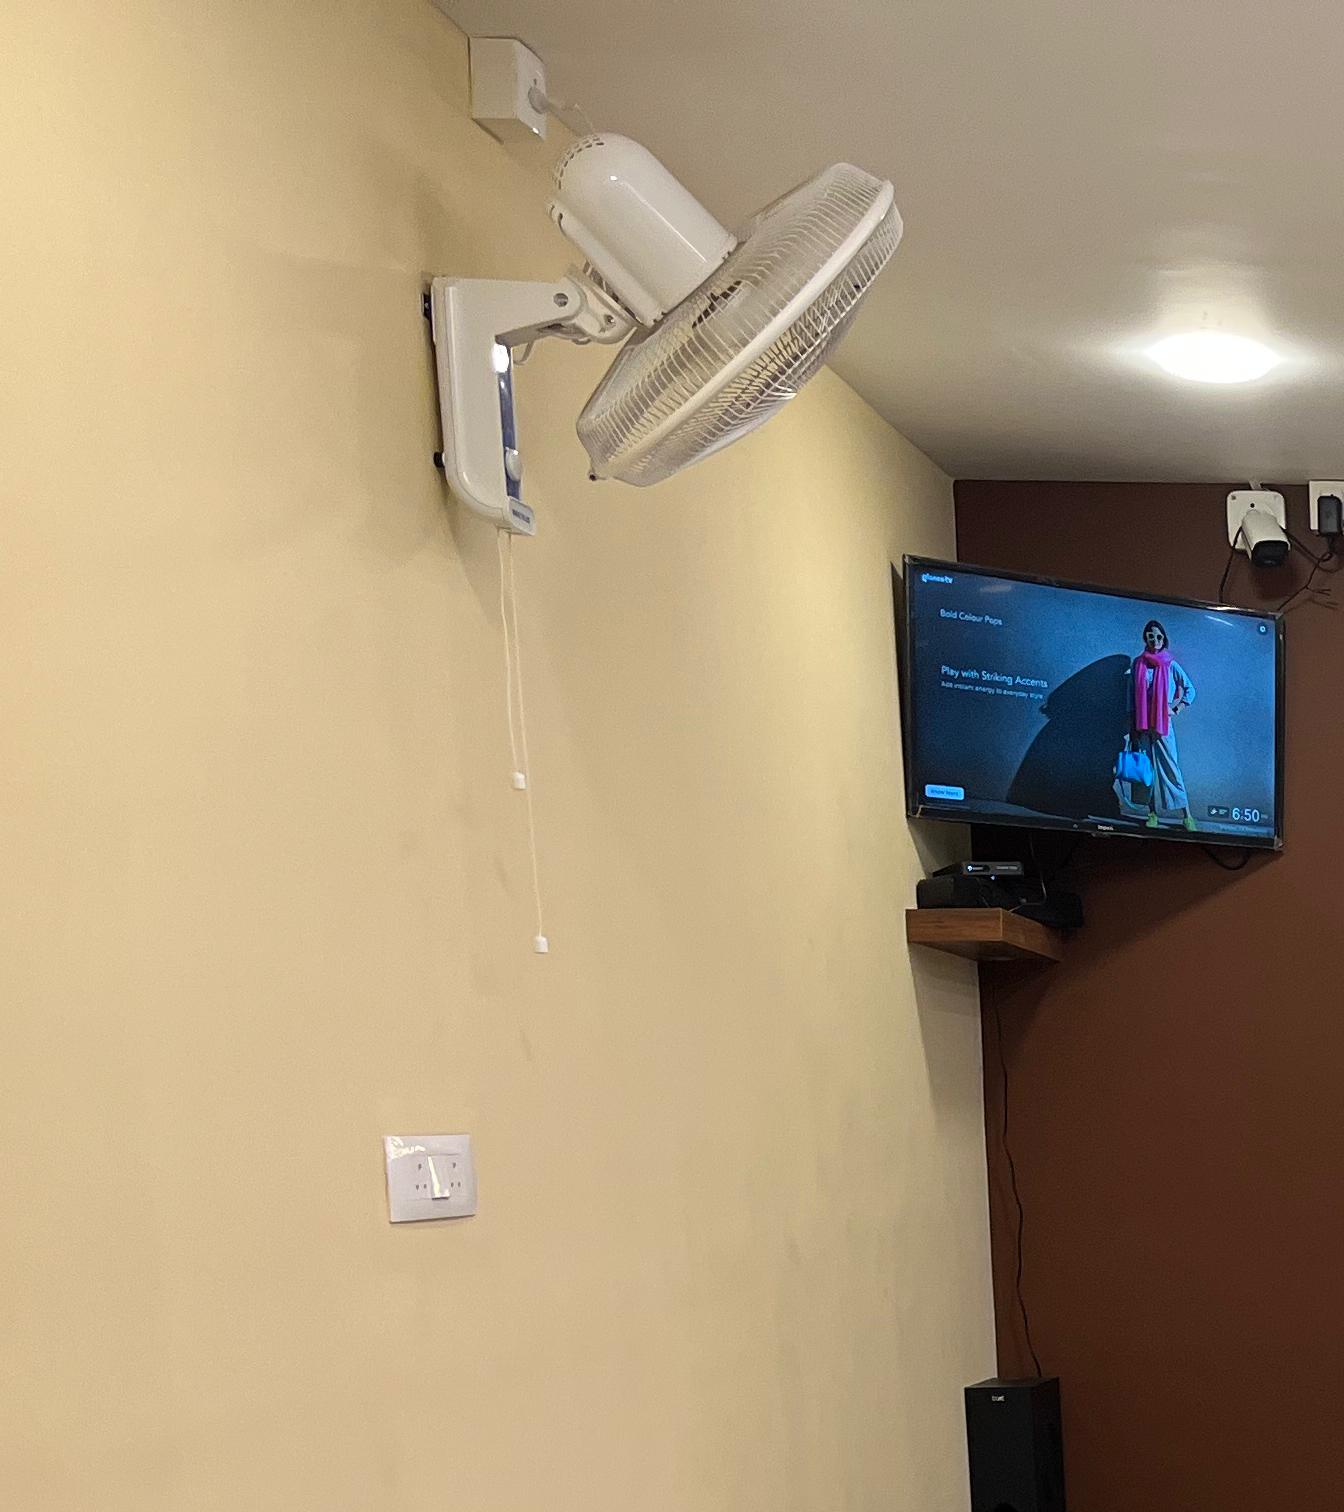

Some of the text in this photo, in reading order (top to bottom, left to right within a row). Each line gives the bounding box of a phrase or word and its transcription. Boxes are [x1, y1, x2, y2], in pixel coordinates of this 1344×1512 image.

[941, 665, 1048, 688] Play with Striking Accents
[1232, 807, 1260, 822] 6:50
